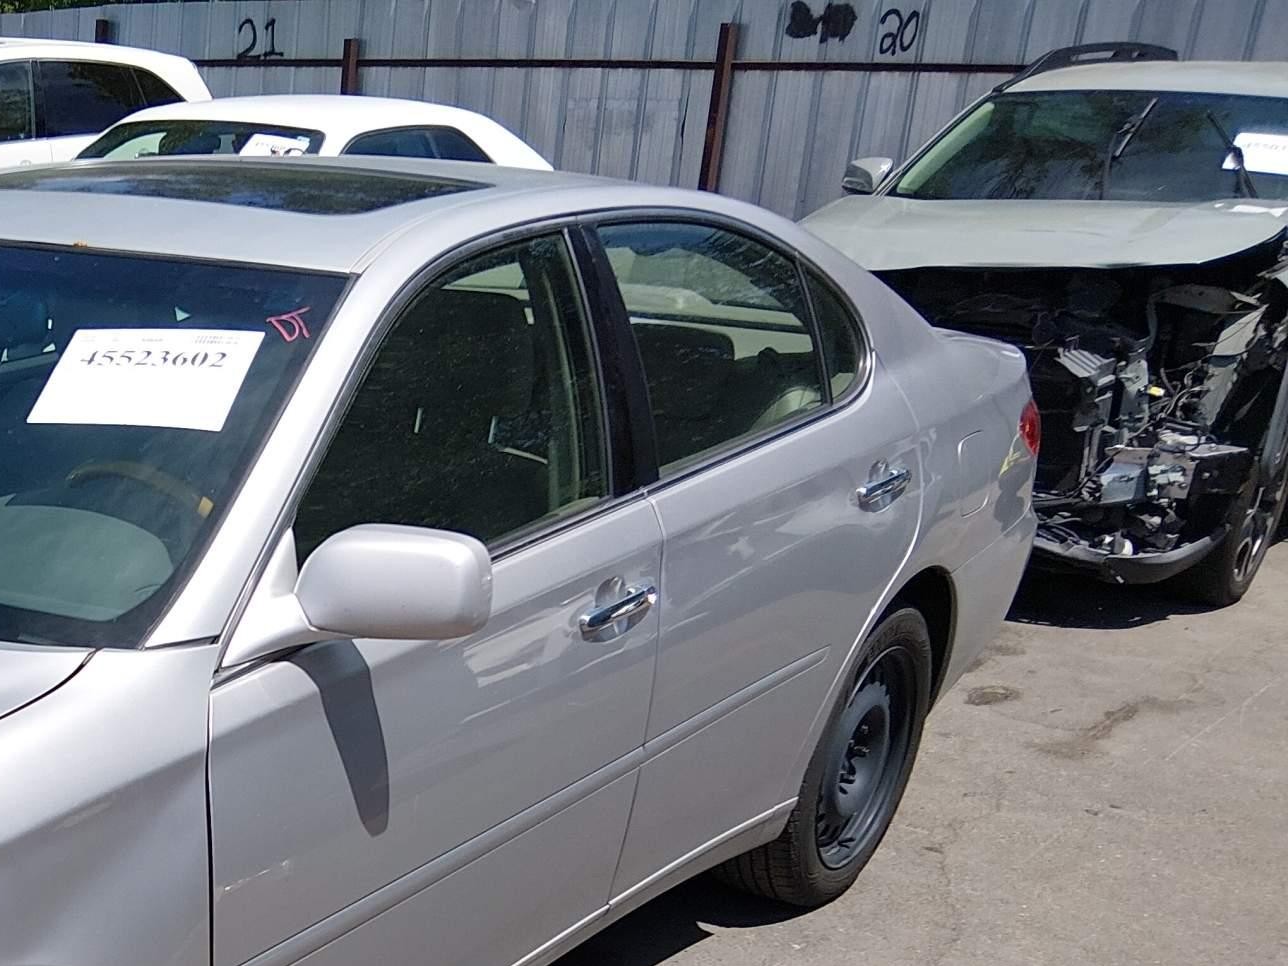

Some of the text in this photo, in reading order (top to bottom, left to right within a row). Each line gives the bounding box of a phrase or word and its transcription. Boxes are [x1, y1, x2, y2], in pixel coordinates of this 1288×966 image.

[237, 18, 284, 59] 21
[880, 8, 921, 56] 20
[80, 350, 227, 368] 45523602
